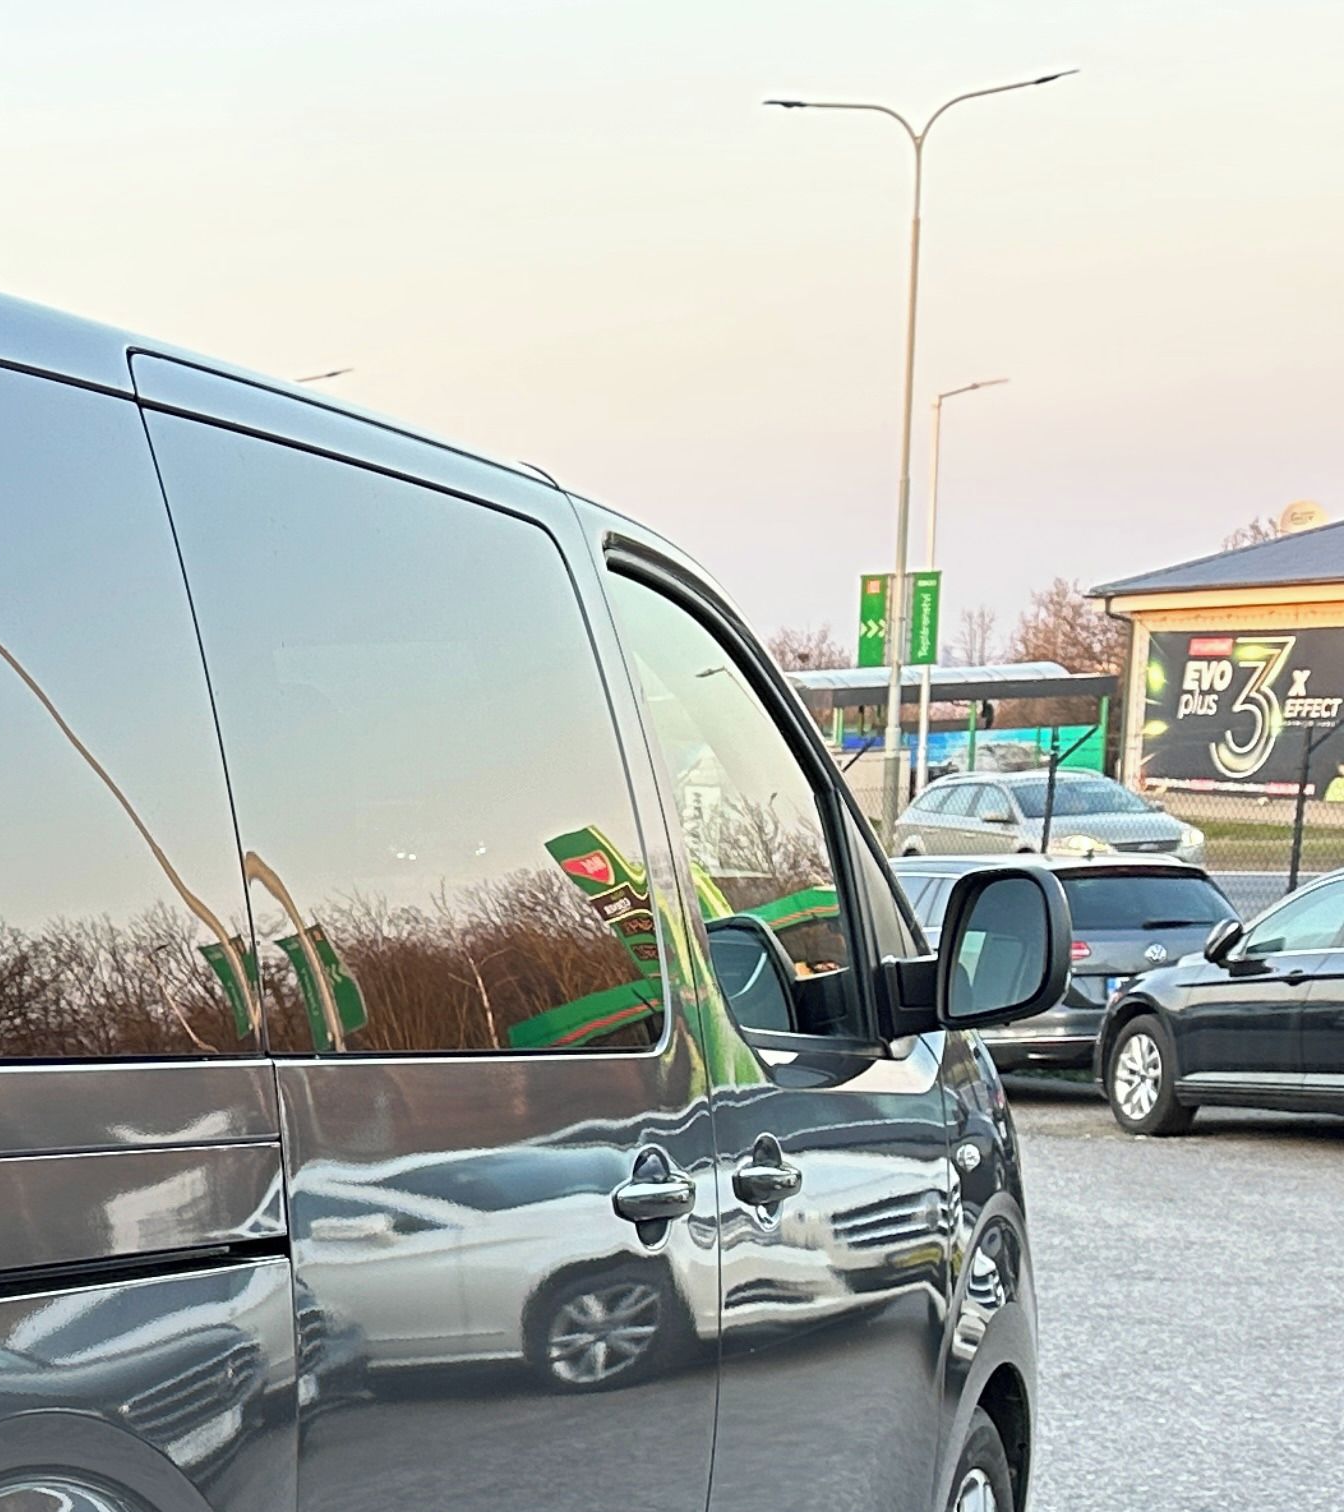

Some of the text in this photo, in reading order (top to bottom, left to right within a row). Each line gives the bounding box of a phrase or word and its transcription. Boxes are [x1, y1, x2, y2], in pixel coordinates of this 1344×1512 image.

[1182, 660, 1233, 691] EVO
[1177, 689, 1219, 720] plus
[1209, 636, 1296, 779] 3
[1283, 698, 1343, 719] EFFECT
